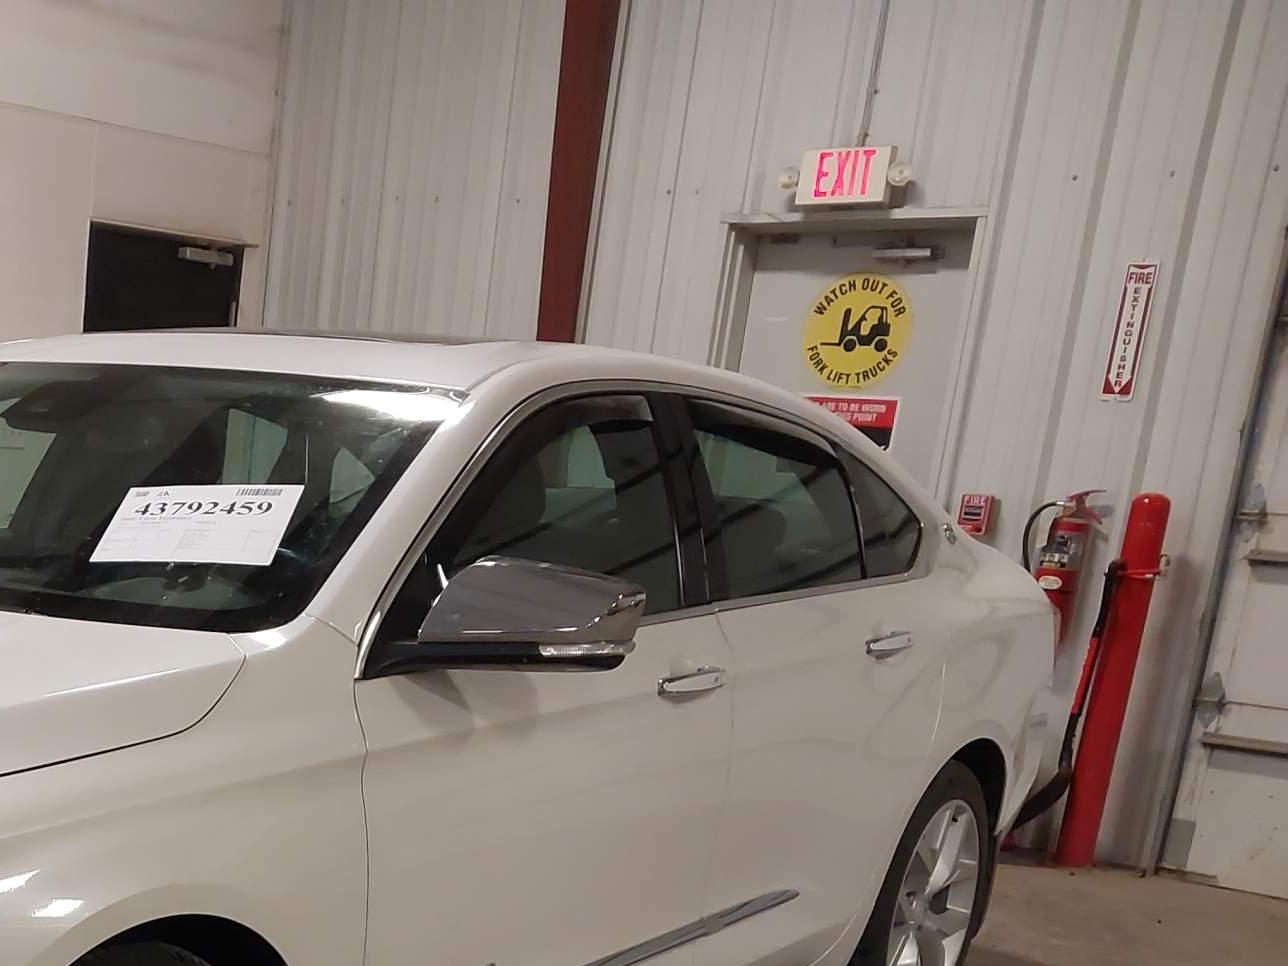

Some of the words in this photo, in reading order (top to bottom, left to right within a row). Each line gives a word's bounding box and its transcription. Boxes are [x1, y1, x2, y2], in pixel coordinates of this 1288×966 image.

[814, 149, 876, 197] EXIT
[814, 280, 857, 316] WATCH
[861, 278, 888, 295] OUT
[886, 290, 906, 318] FOR
[1128, 272, 1153, 284] FIRE
[1114, 287, 1142, 388] EXTINGUISHER
[807, 345, 829, 376] FORK
[826, 369, 851, 385] LIFT
[855, 348, 899, 384] TRUCKS
[134, 501, 272, 515] 43792459
[965, 495, 986, 505] FIRE
